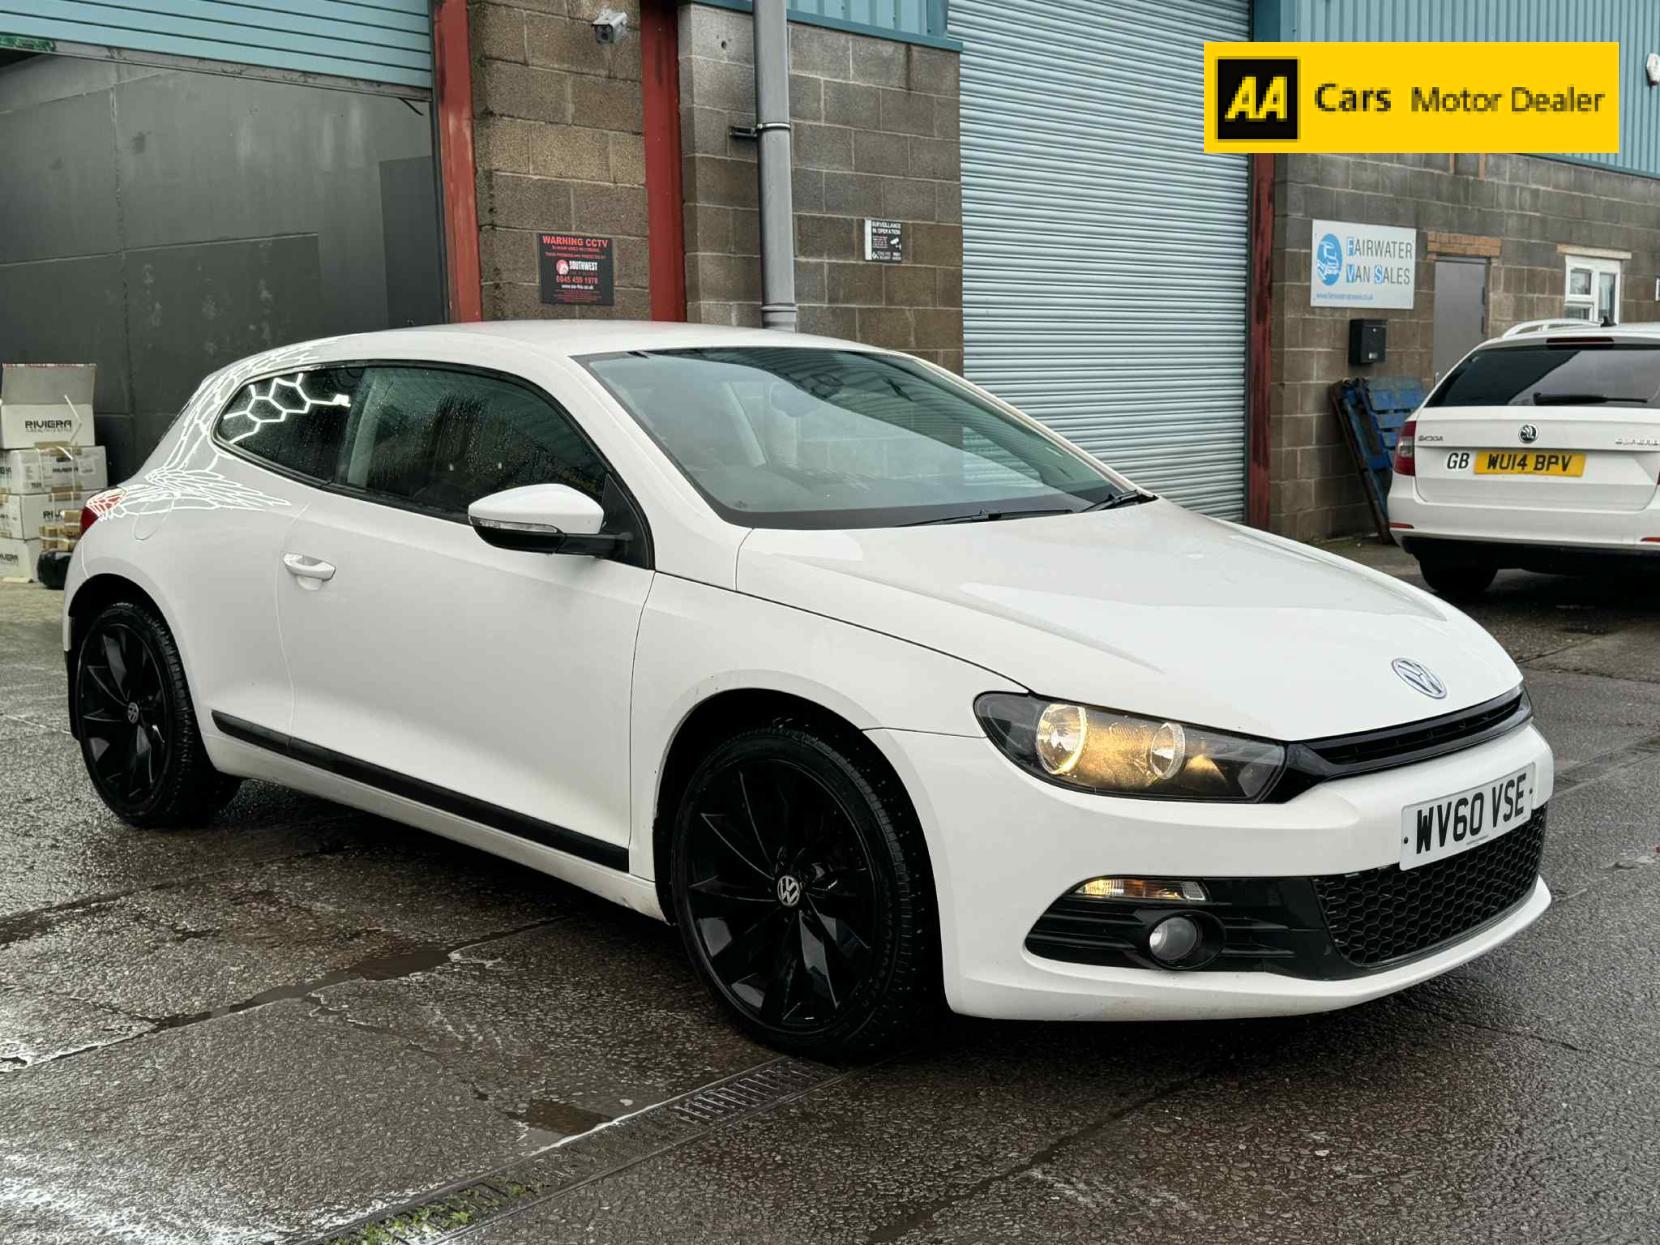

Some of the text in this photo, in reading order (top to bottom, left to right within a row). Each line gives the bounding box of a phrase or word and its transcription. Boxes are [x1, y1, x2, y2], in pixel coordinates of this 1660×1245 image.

[543, 236, 608, 248] WARNING CCTV
[1346, 237, 1413, 259] FAIRWATER
[1346, 264, 1411, 286] VAN SALES
[25, 420, 72, 429] RIVIERA
[1446, 452, 1471, 470] GB
[1487, 453, 1573, 472] WU14 BPV
[1416, 772, 1527, 854] WV60 VSE
